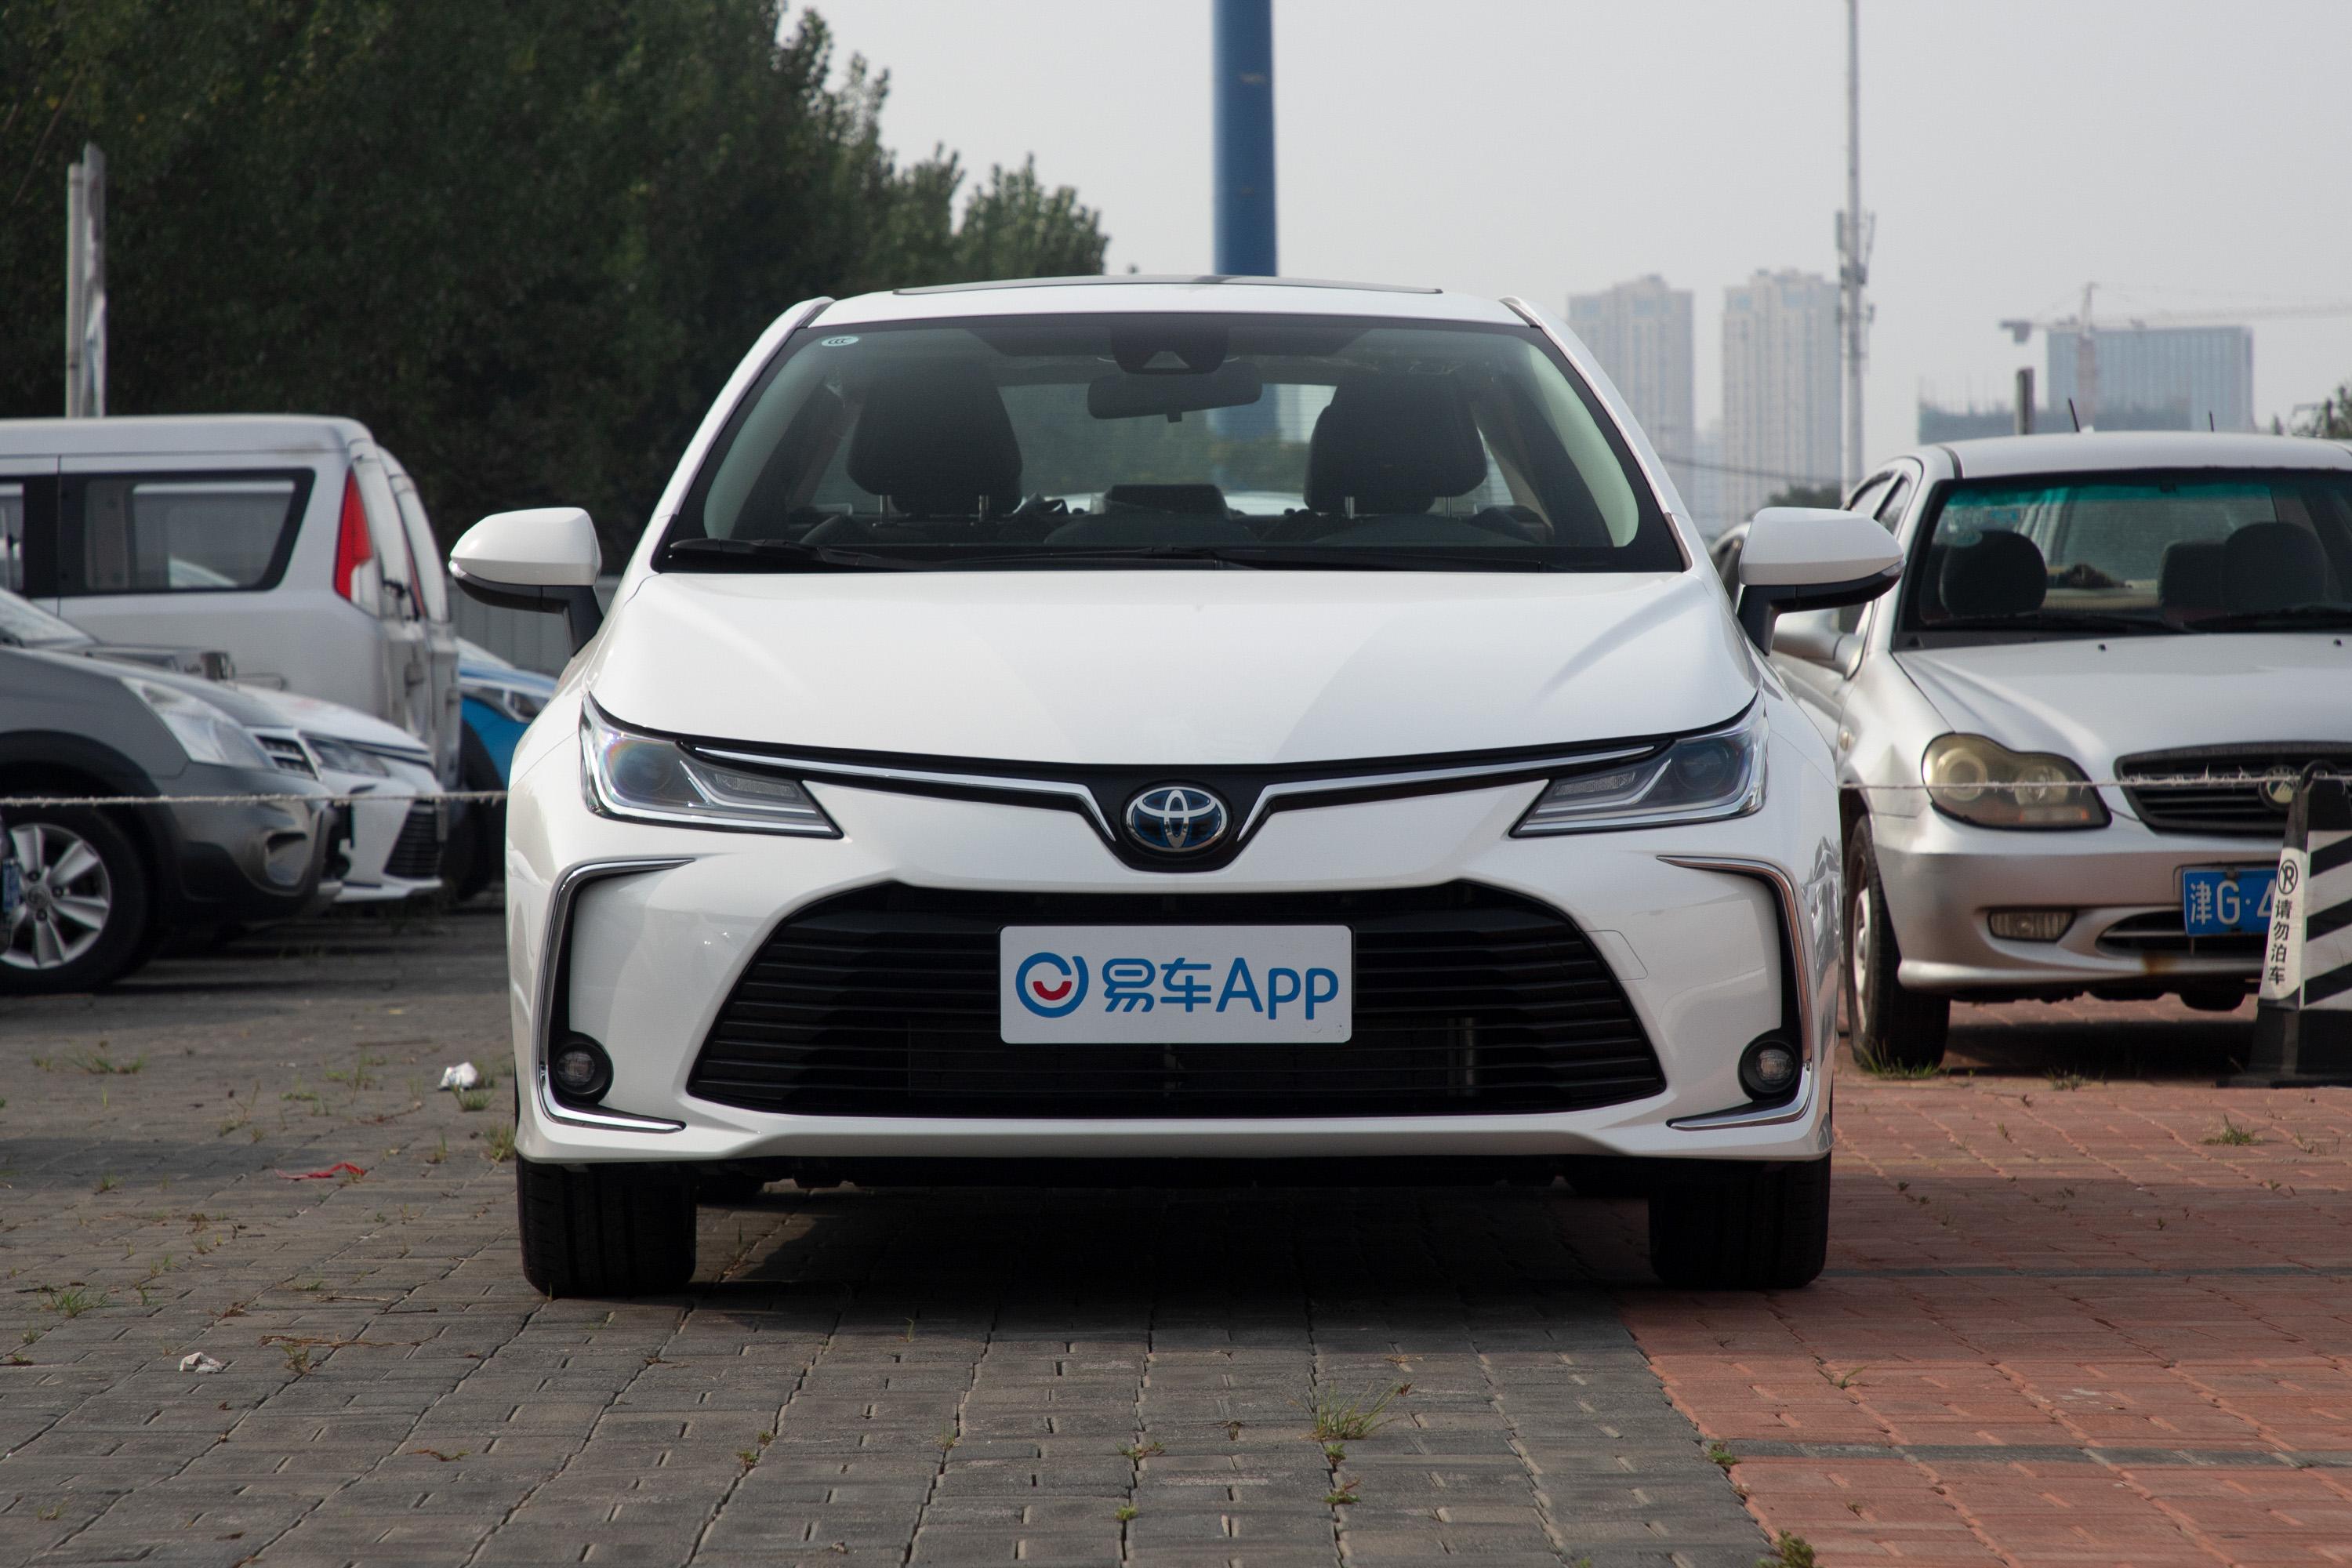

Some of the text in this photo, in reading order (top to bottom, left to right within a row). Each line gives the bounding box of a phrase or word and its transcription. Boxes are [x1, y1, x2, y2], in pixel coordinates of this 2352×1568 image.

[2268, 899, 2292, 985] 请勿泊车
[1102, 957, 1338, 1019] 易车App
